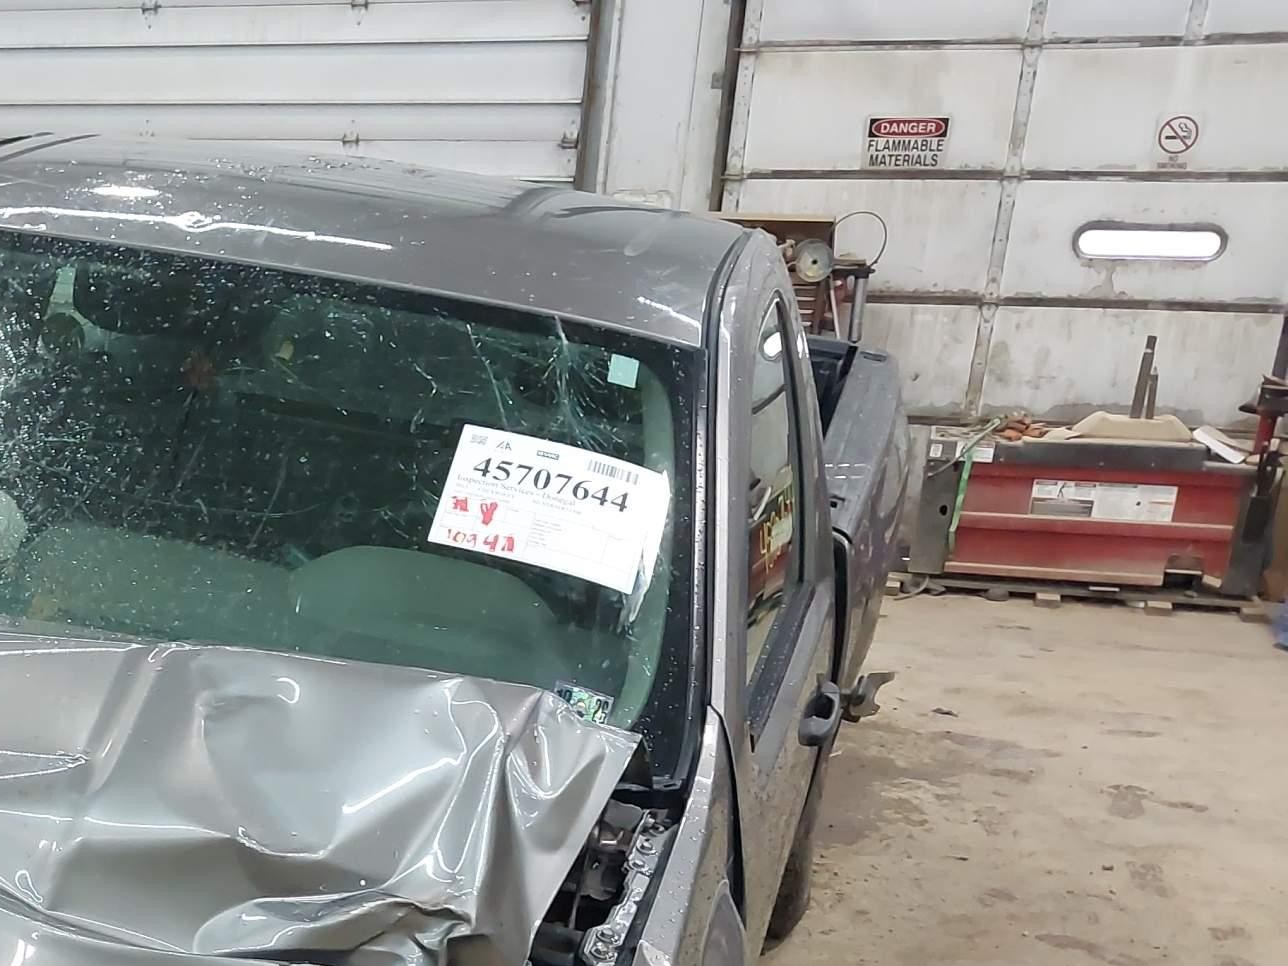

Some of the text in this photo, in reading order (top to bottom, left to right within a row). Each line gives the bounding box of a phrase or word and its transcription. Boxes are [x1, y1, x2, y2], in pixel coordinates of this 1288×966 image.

[880, 122, 937, 134] DANGER
[867, 139, 945, 153] FLAMMABLE
[868, 153, 939, 167] MATERIALS
[473, 457, 629, 512] 45707644
